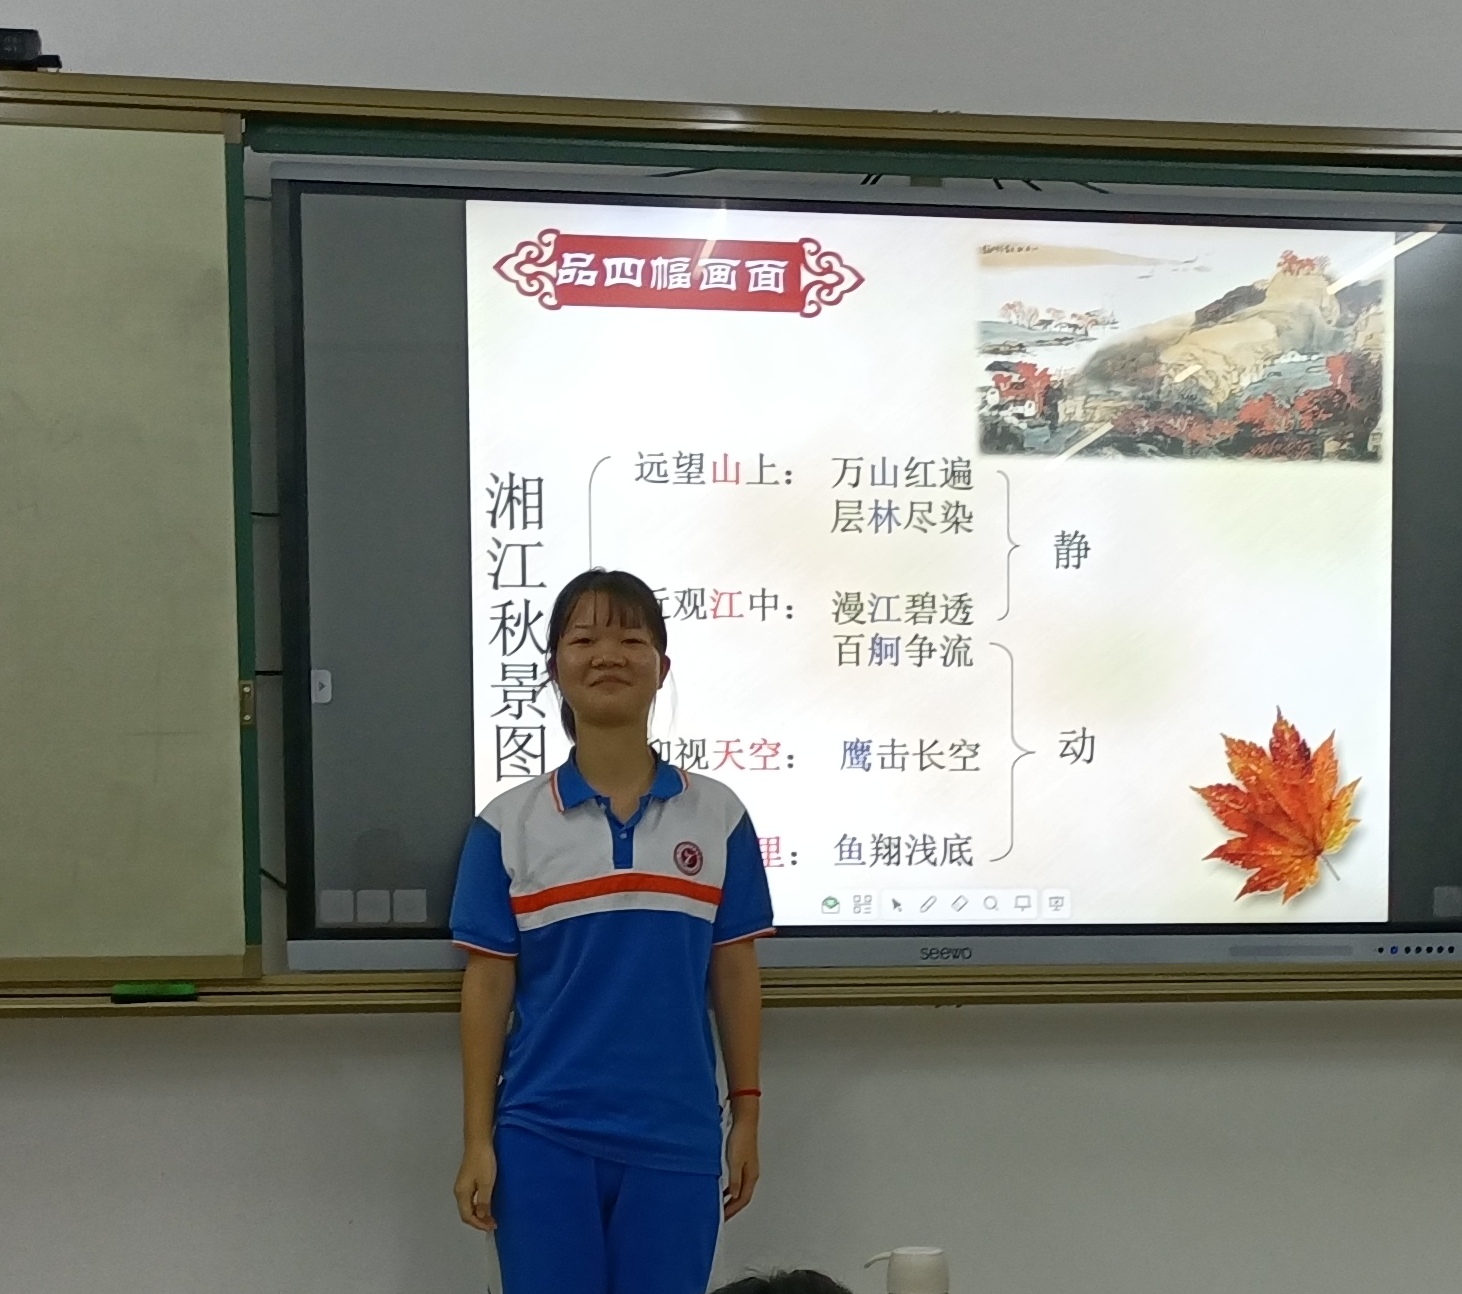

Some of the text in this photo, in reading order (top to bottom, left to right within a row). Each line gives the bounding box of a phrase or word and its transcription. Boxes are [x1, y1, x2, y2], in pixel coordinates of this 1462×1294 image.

[555, 251, 790, 295] 品四幅画面
[634, 450, 794, 487] 远望山上：
[831, 455, 975, 491] 万山红遍
[830, 499, 975, 535] 层林尽染
[1053, 529, 1092, 570] 静
[485, 471, 548, 782] 湘江秋景图
[831, 590, 975, 627] 漫江碧透
[832, 633, 975, 668] 百舸争流
[840, 738, 981, 773] 鹰击长空
[1057, 726, 1096, 765] 动
[832, 833, 975, 868] 鱼翔浅底
[919, 947, 972, 960] seewo
